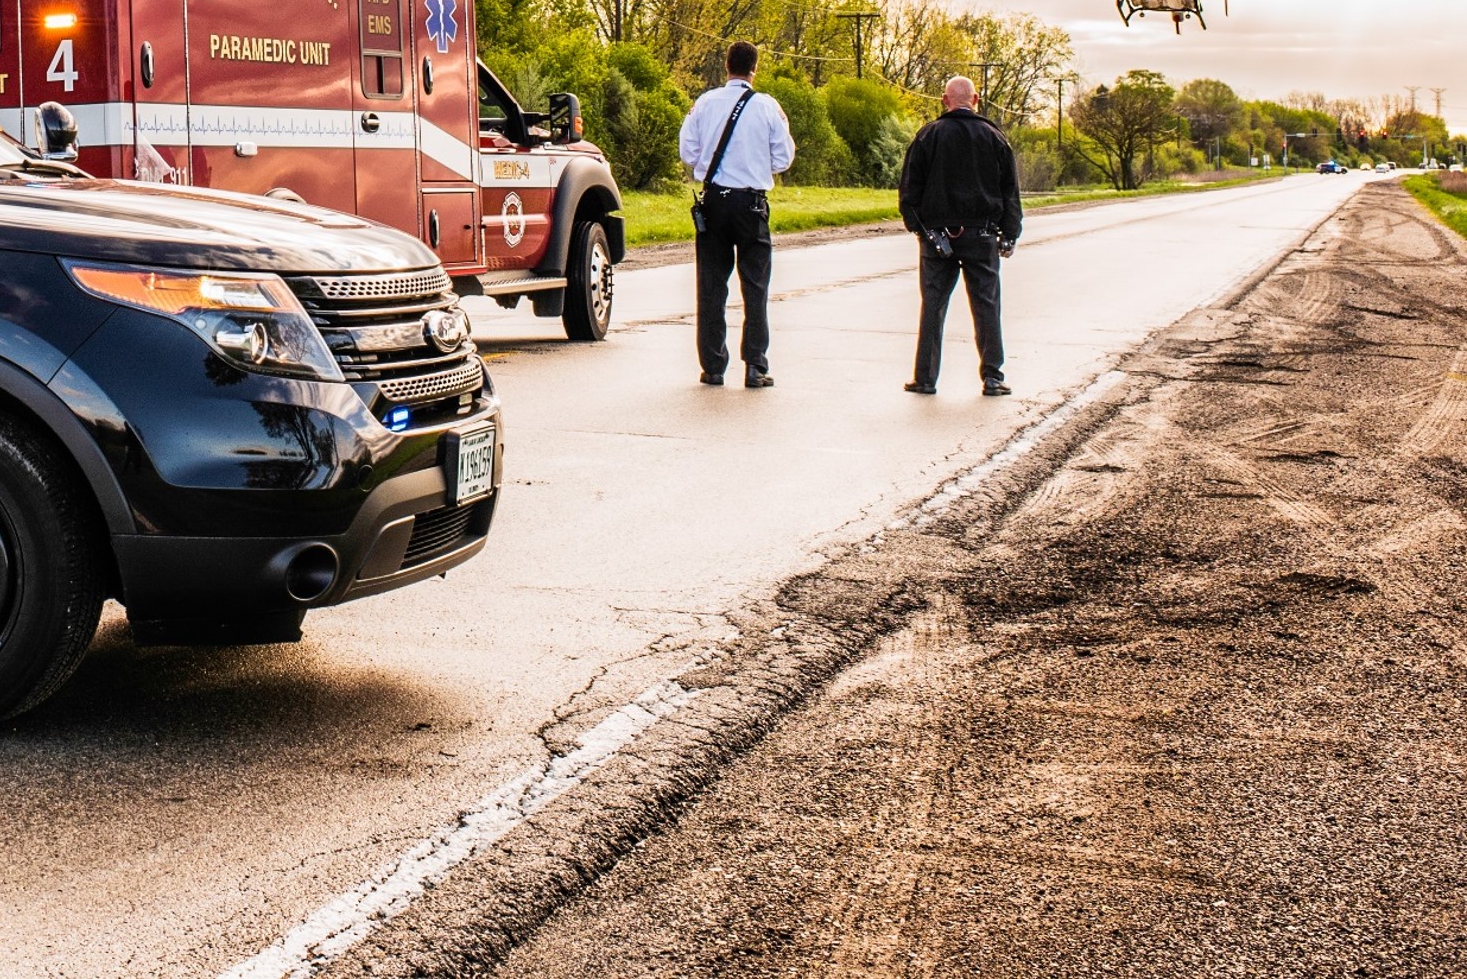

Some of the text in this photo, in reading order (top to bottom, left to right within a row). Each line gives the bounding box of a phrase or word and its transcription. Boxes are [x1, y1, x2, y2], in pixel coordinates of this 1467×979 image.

[368, 14, 391, 35] EMS
[46, 39, 79, 92] 4
[210, 34, 331, 66] PARAMEDIC UNIT
